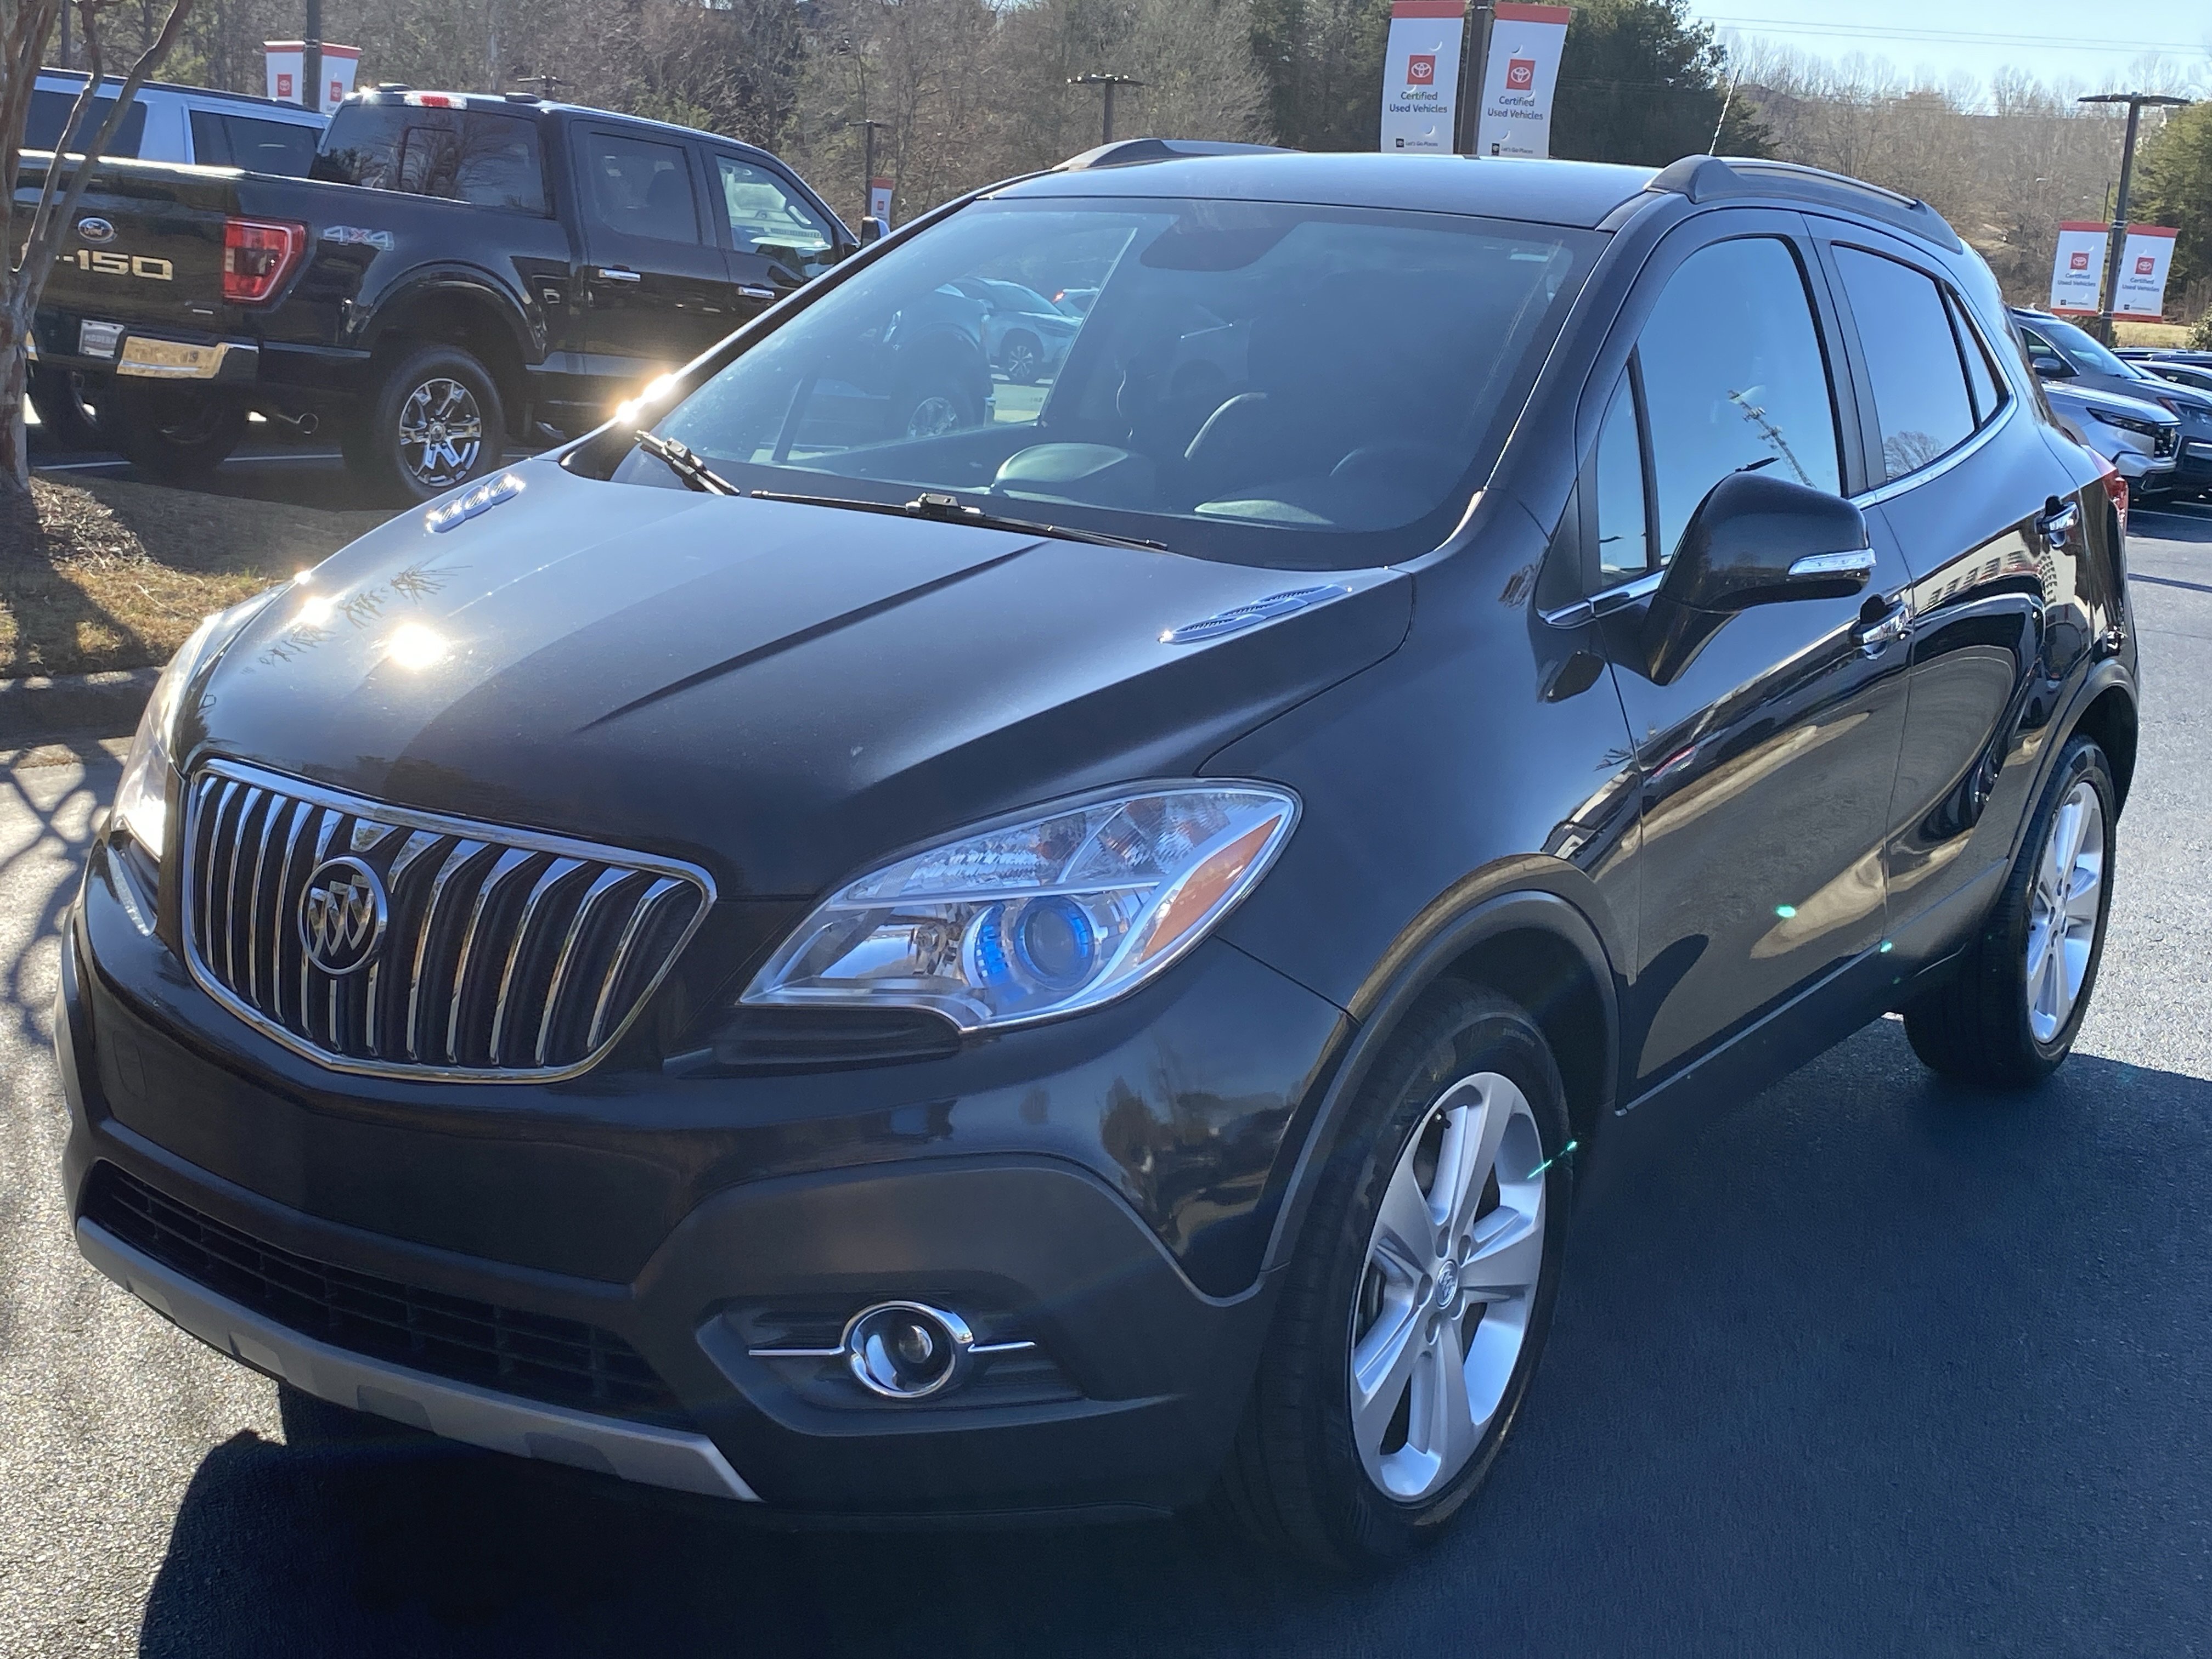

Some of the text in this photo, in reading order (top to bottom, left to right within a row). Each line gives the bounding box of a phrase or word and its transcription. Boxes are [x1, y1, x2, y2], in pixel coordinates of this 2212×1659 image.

[1401, 91, 1438, 100] Certified
[1499, 95, 1535, 106] Certified
[1390, 104, 1448, 113] Used Vehicles
[1488, 108, 1543, 120] Used Vehicles
